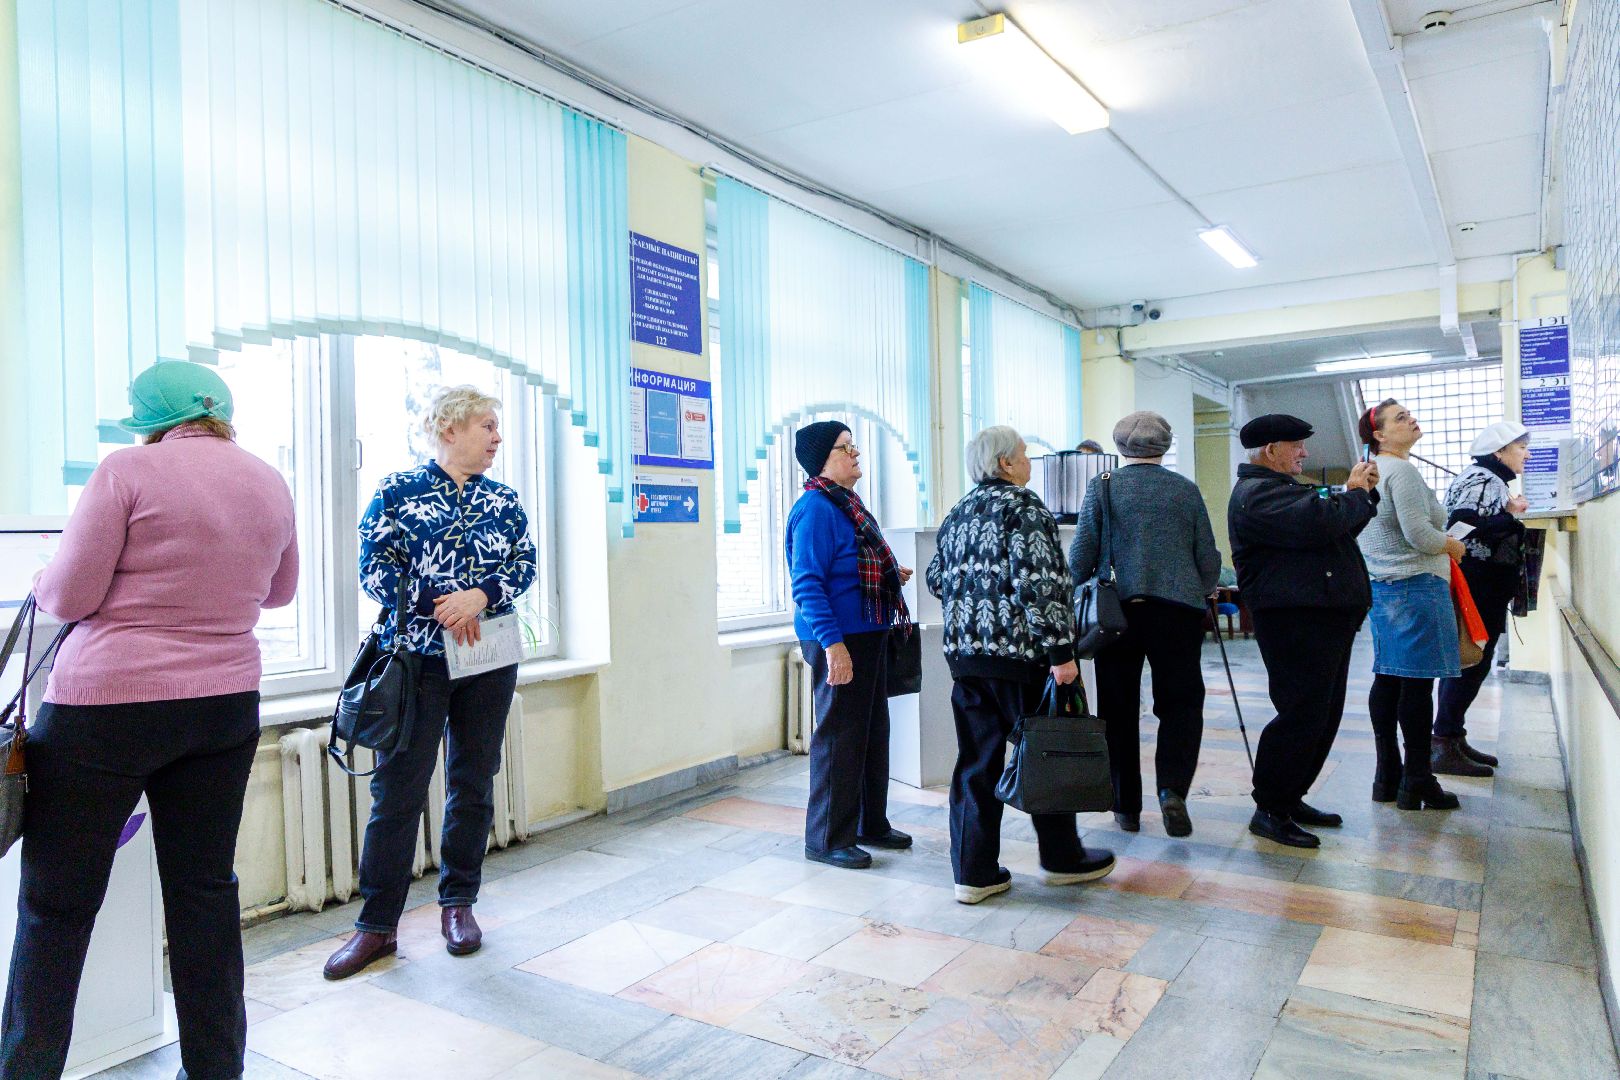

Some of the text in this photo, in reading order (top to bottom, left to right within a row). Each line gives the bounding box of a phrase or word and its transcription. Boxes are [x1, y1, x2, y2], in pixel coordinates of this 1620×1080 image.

[661, 248, 698, 265] ПАЦИЕНТЫ!
[656, 335, 667, 346] 122
[1540, 378, 1546, 387] 2
